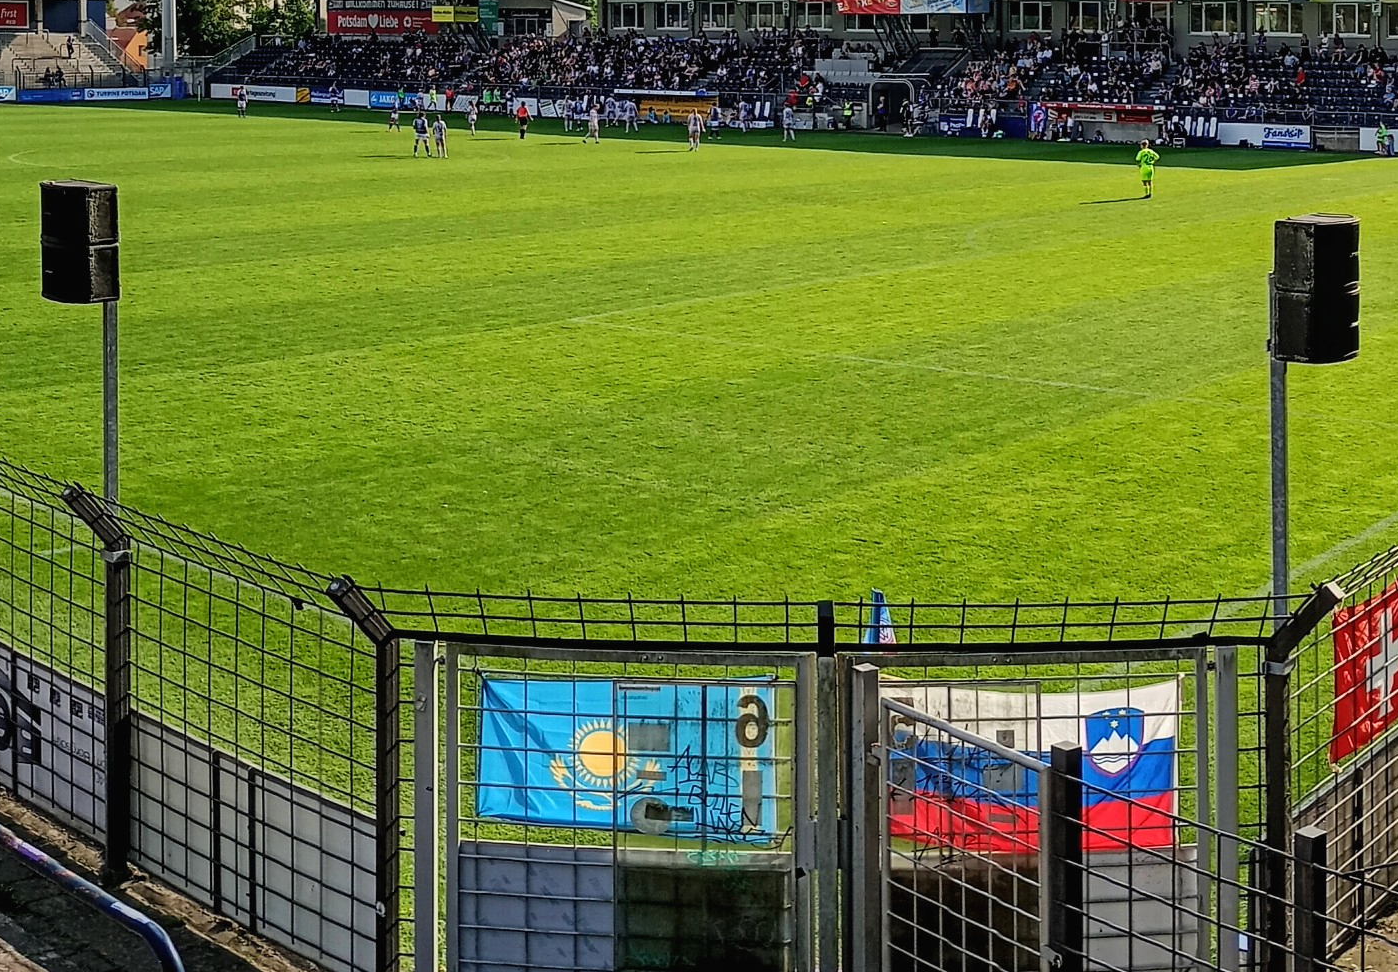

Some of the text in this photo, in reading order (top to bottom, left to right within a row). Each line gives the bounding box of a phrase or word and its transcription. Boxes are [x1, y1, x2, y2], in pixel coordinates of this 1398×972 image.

[337, 15, 368, 28] Potsdam
[379, 15, 399, 28] Liebe
[149, 87, 164, 96] SAP
